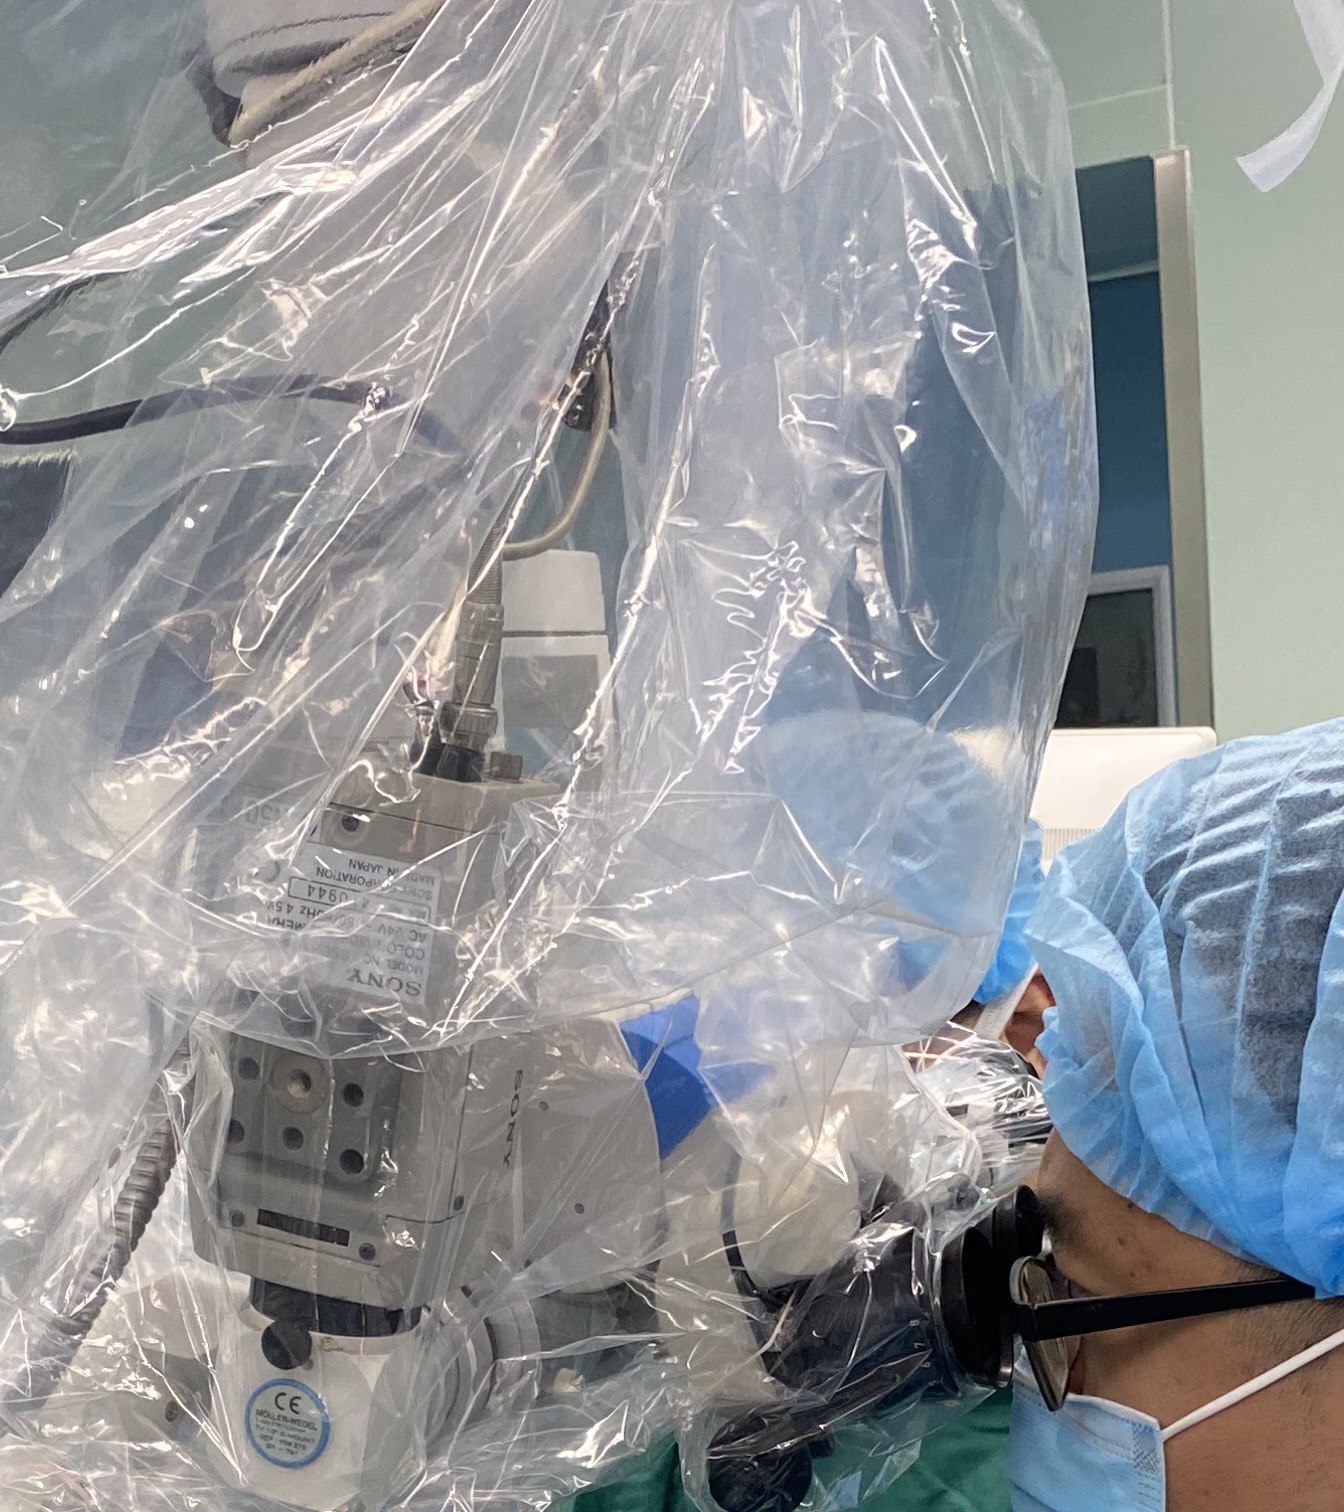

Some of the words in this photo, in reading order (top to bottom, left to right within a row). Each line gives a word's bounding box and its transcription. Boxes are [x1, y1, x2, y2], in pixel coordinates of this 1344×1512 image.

[349, 858, 383, 874] JAPAN
[408, 929, 427, 944] AC
[386, 959, 424, 976] MODEL
[347, 968, 422, 996] SONY
[503, 1069, 524, 1168] SONY
